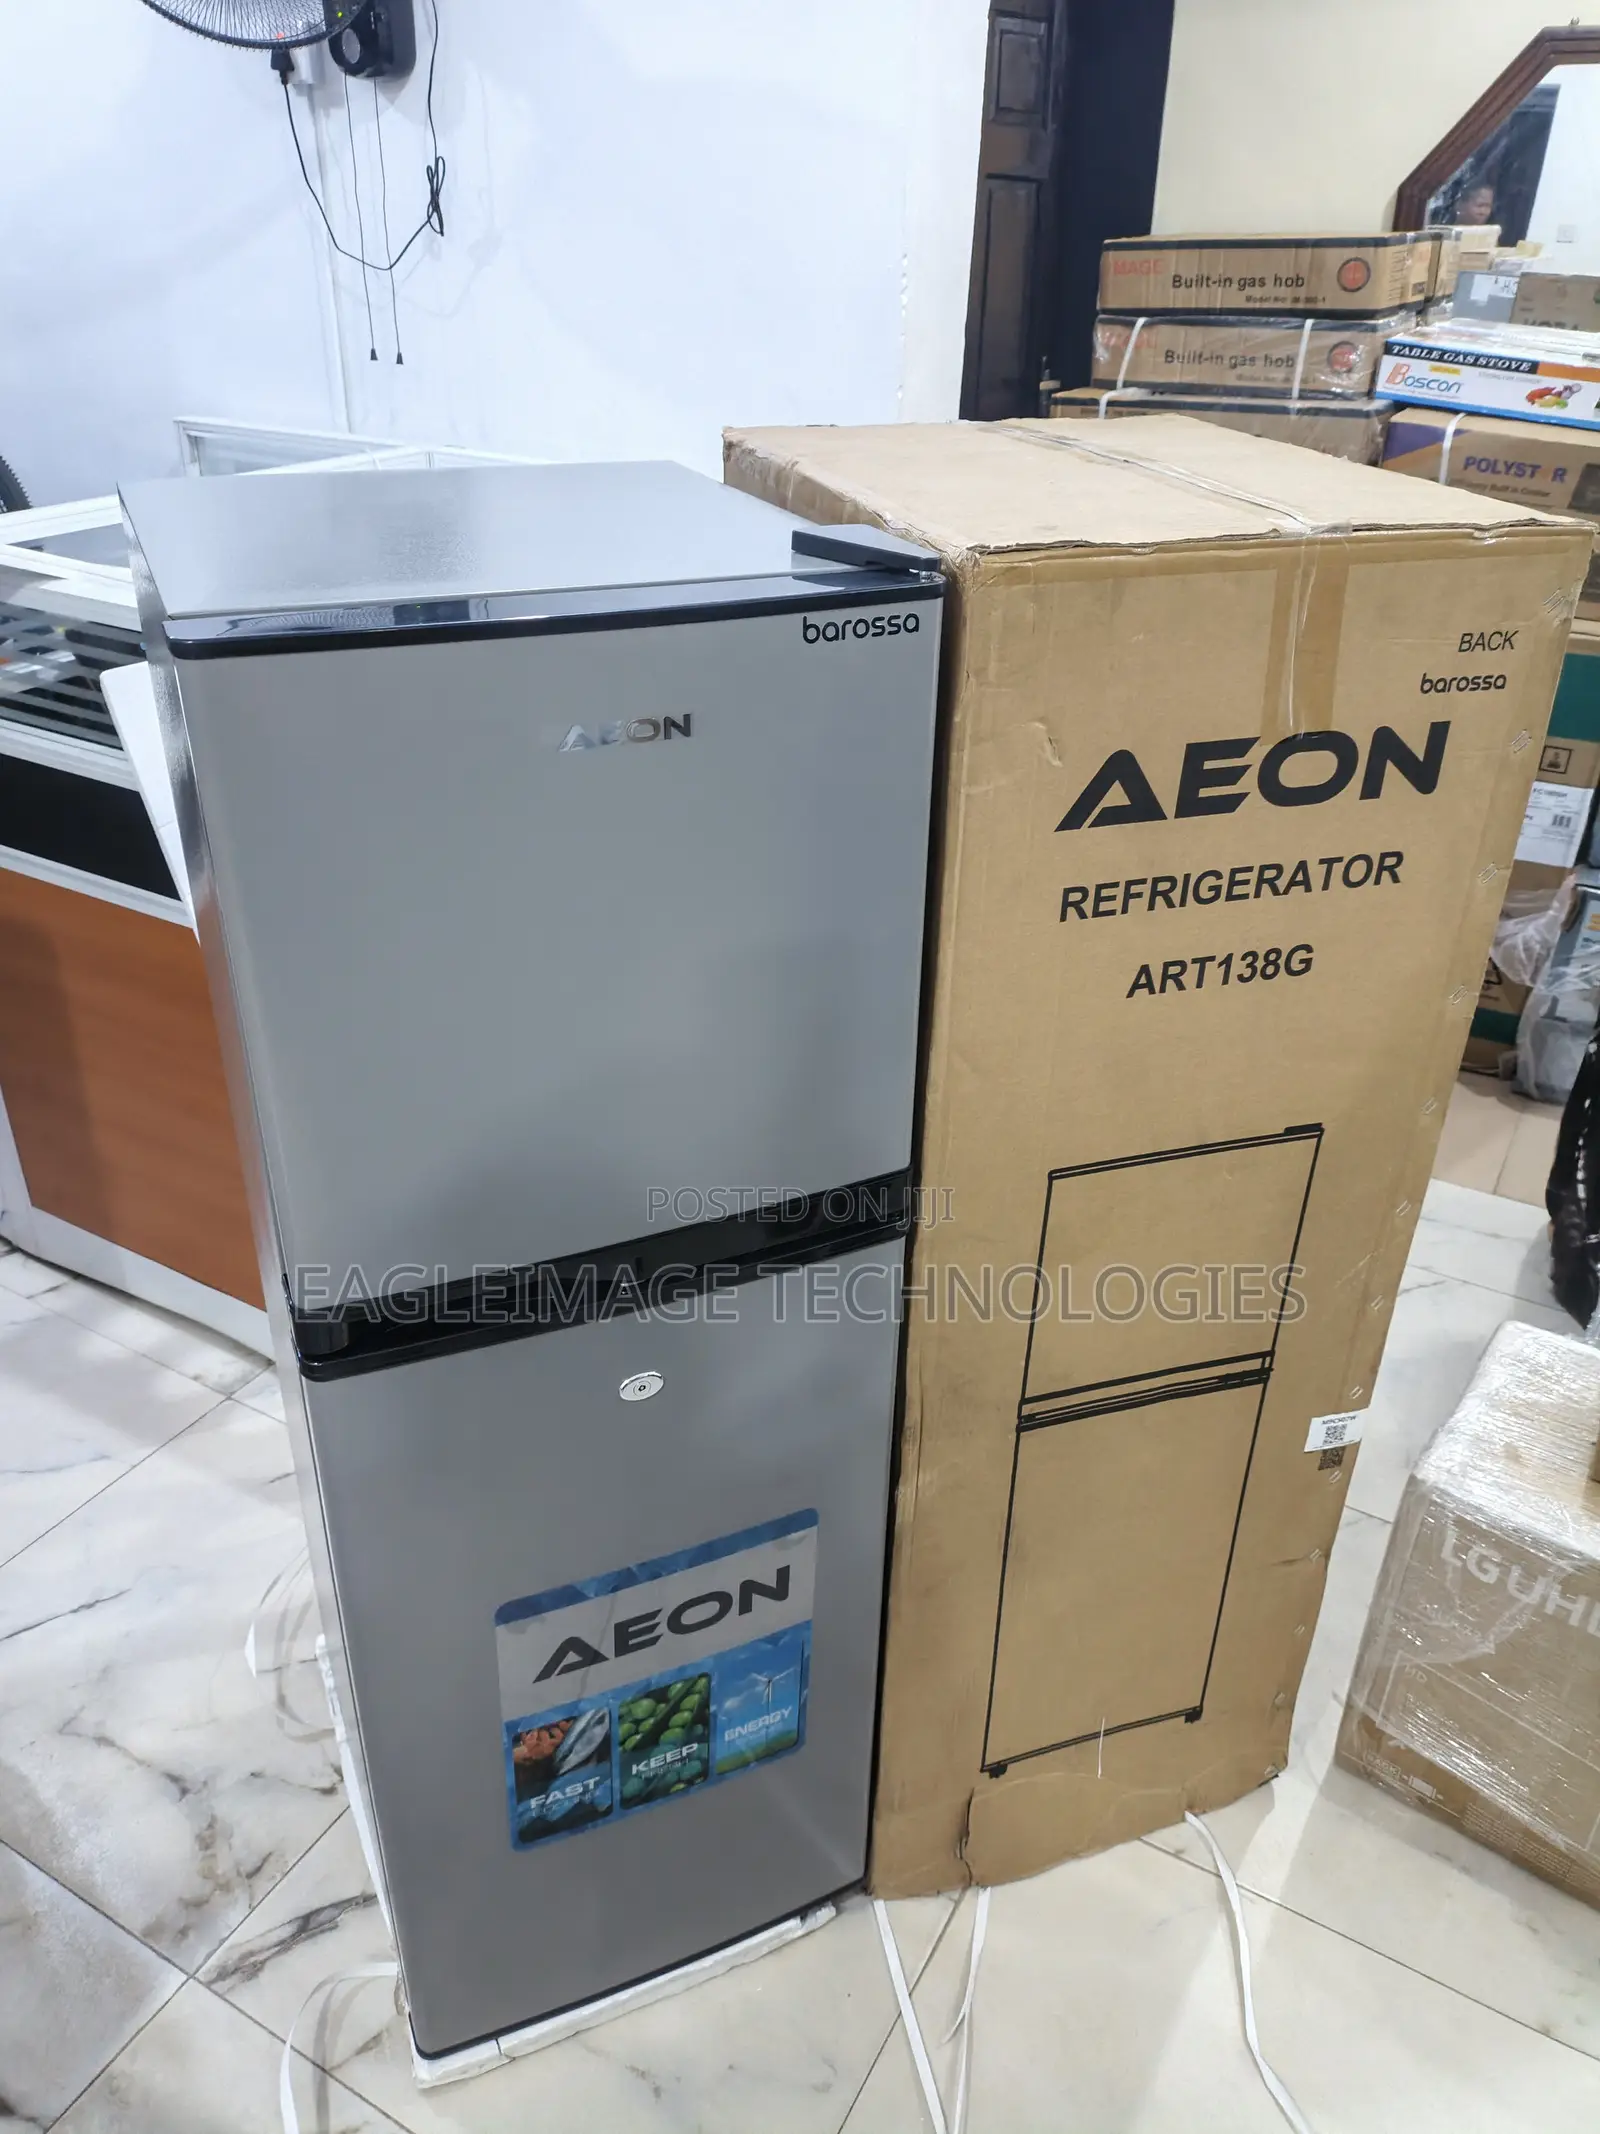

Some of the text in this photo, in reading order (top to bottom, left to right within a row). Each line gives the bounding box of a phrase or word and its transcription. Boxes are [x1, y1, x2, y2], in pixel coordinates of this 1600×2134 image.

[1172, 273, 1305, 291] Built-in gas hob
[1164, 350, 1295, 370] Built-in gas hob
[1392, 345, 1440, 361] TABLE
[1443, 350, 1476, 366] GAS
[1477, 356, 1533, 372] STOVE
[802, 612, 920, 644] barossa
[1458, 630, 1518, 652] BACK
[1420, 673, 1507, 694] barossa
[1054, 721, 1452, 832] AEON
[1059, 851, 1404, 922] REFRIGERATOR
[1126, 943, 1314, 999] ART138G
[532, 1564, 790, 1684] AEON
[724, 1705, 792, 1742] ENERGY
[631, 1742, 698, 1775] KEEP
[530, 1776, 600, 1809] FAST
